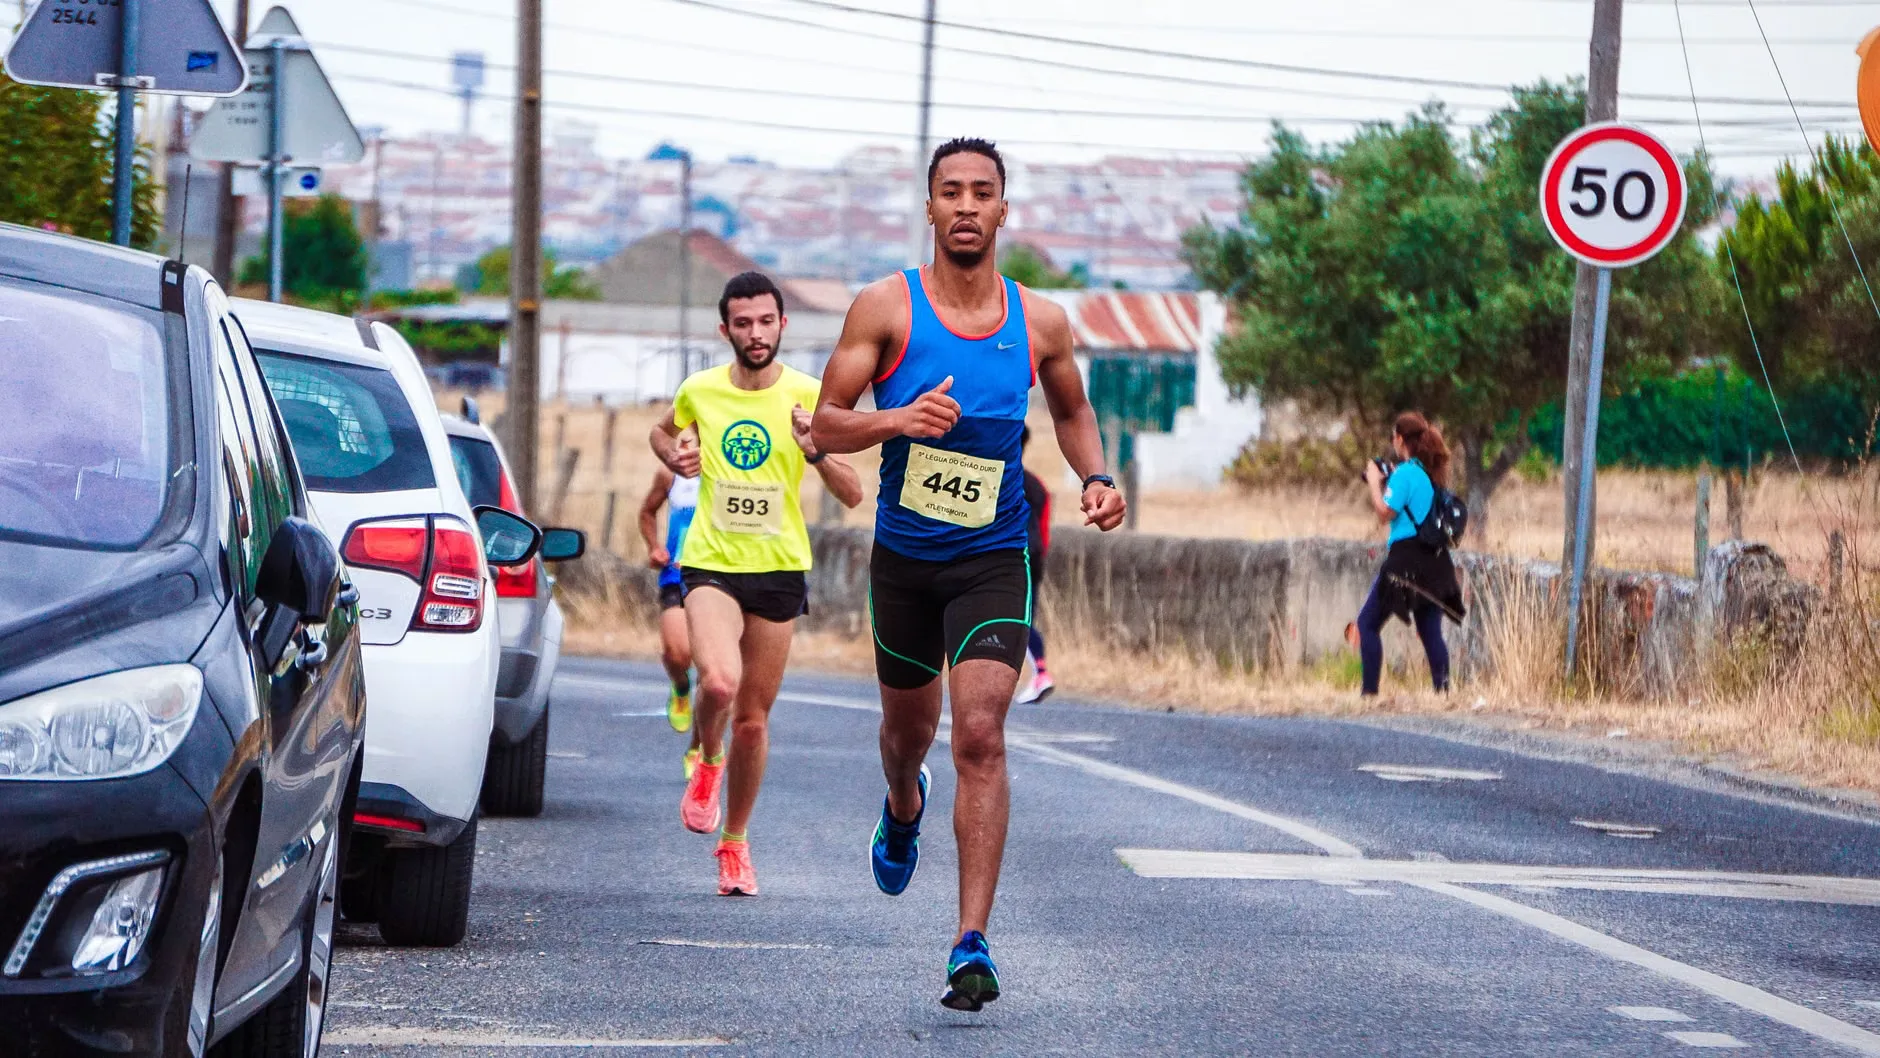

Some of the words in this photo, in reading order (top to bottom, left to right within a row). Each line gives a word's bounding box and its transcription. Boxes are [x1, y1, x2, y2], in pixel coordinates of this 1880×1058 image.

[52, 8, 97, 25] 2544
[1569, 166, 1656, 221] 50
[948, 458, 959, 466] DO
[922, 472, 982, 503] 445
[726, 496, 769, 516] 593
[360, 607, 392, 620] C3
